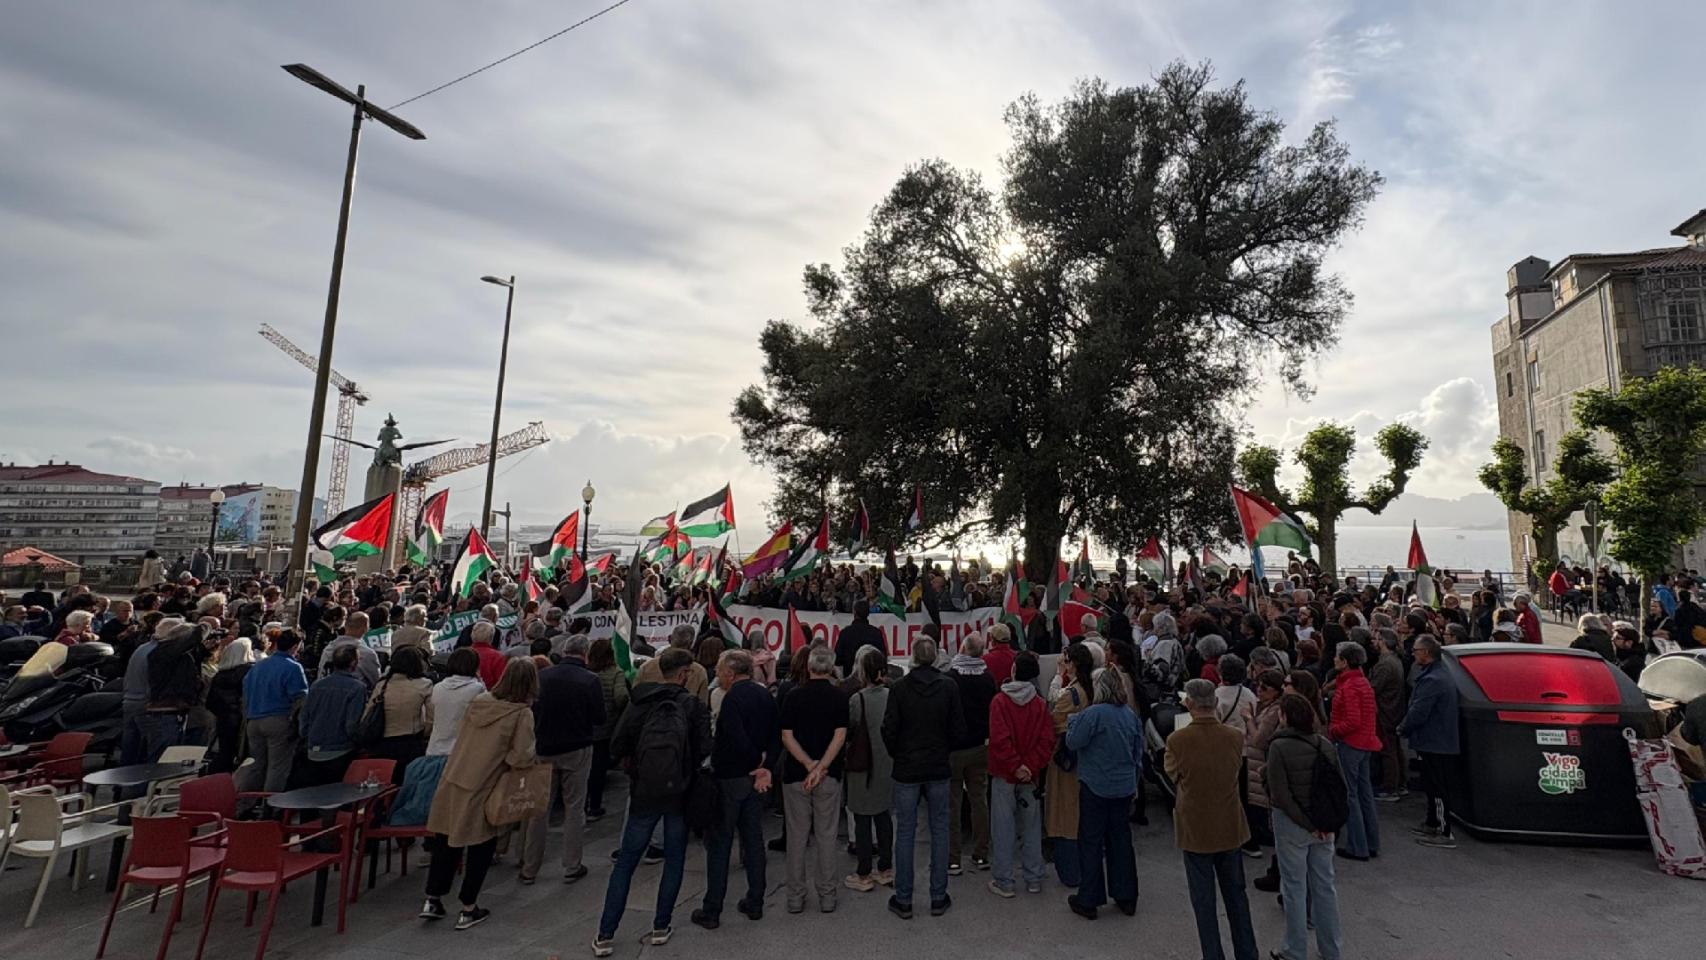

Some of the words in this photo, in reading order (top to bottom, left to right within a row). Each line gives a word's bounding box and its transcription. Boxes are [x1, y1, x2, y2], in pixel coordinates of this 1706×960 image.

[594, 615, 617, 628] CON
[639, 612, 700, 627] LESTINA
[879, 617, 995, 657] ALETINA
[1546, 753, 1578, 769] Vigo
[1541, 765, 1584, 778] cidade
